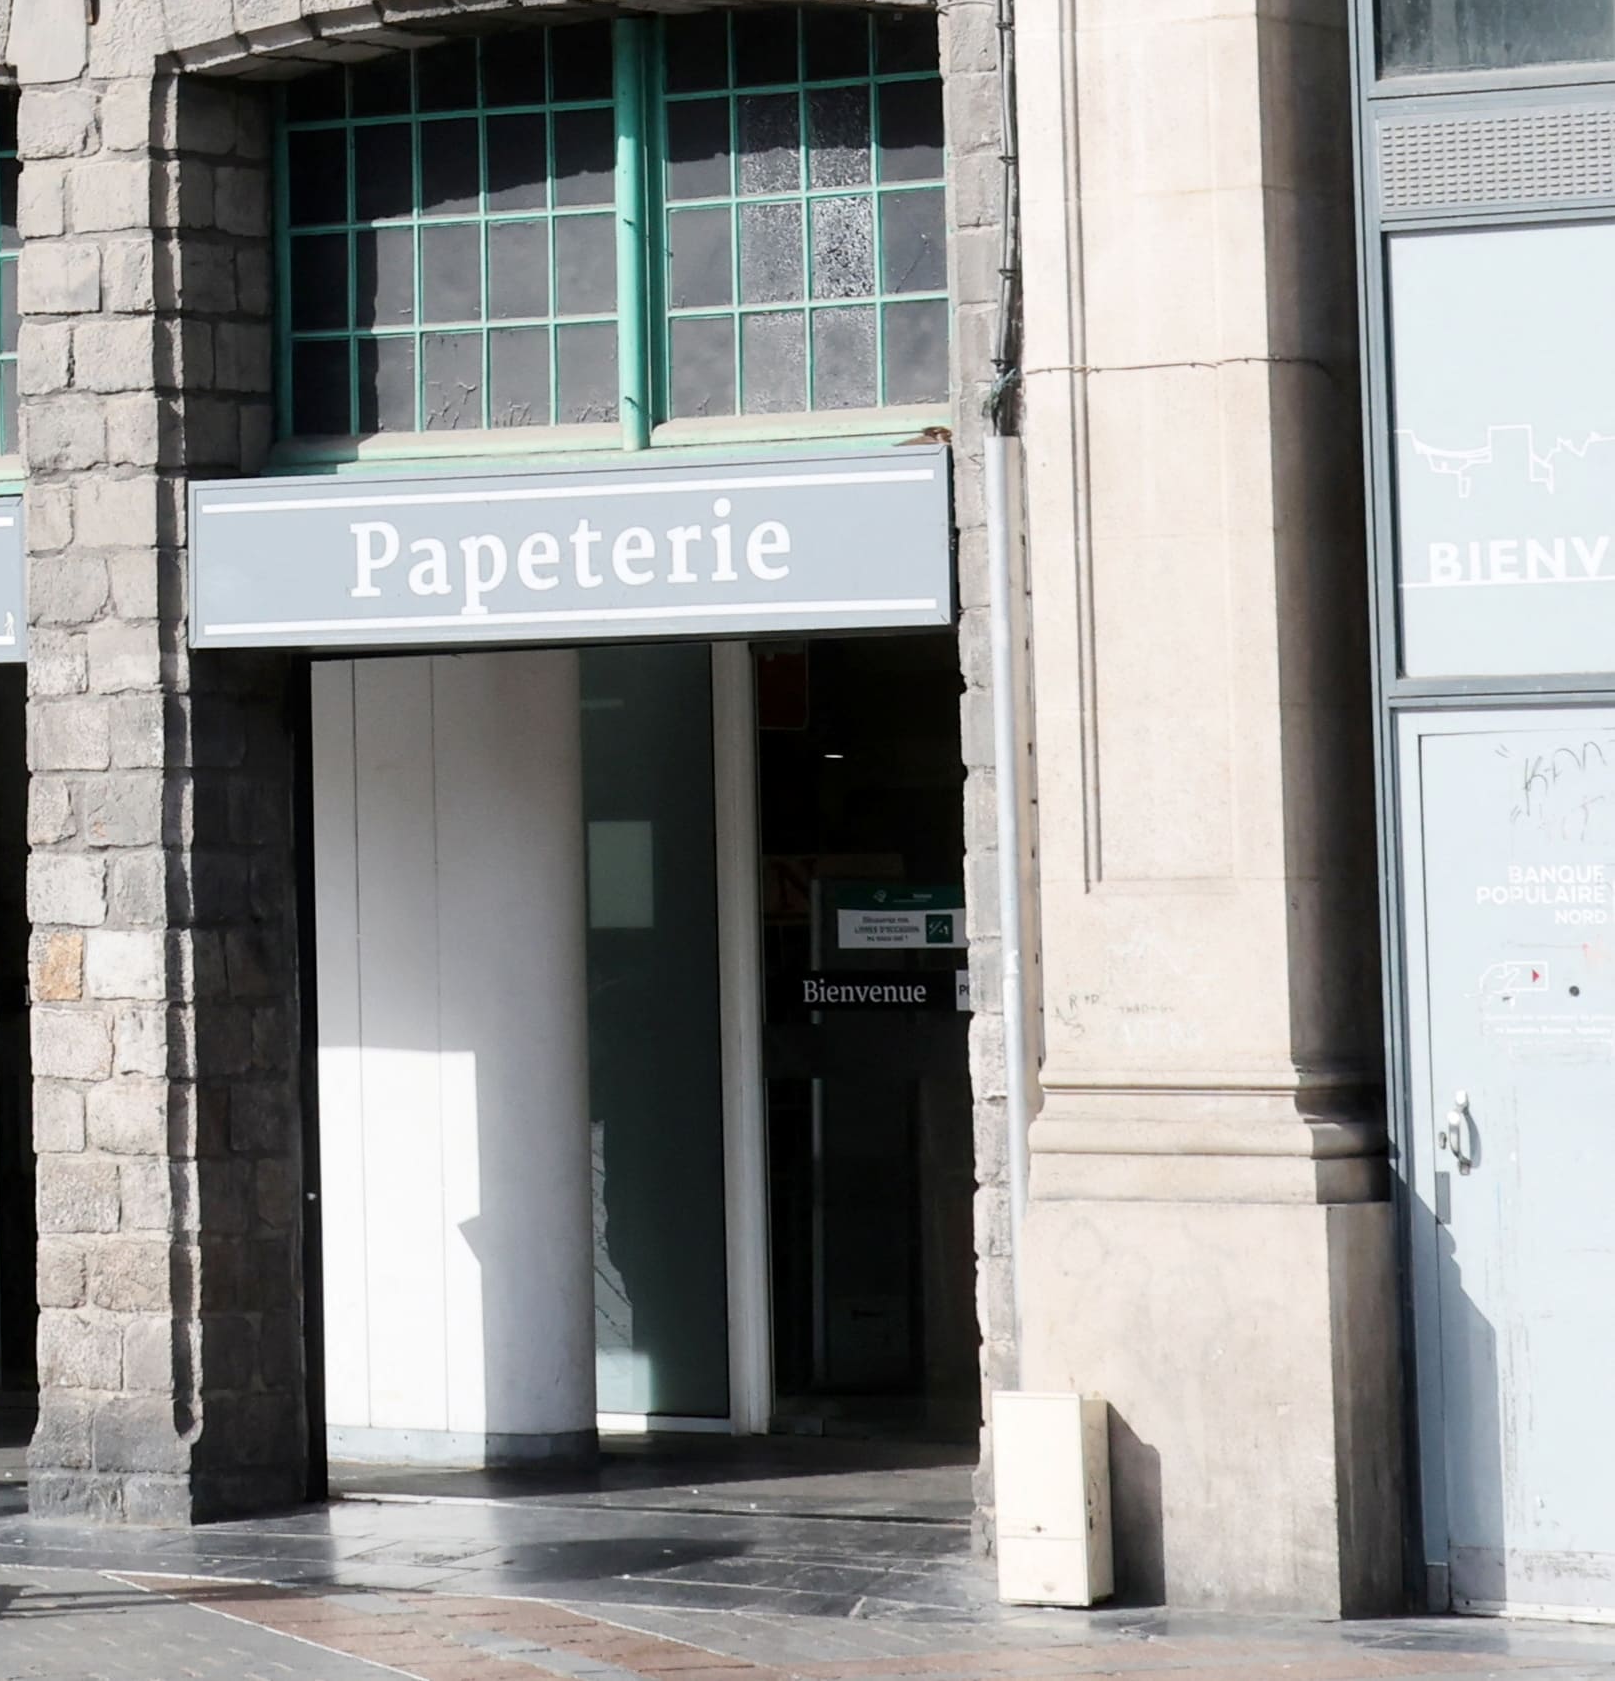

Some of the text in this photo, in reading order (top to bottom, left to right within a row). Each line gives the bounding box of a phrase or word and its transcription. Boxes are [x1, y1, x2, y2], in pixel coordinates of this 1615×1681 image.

[349, 496, 794, 616] Papeterie
[1428, 535, 1611, 583] BIENV
[1507, 865, 1605, 884] BANQUE
[1476, 885, 1607, 905] POPULAIRE
[1554, 909, 1608, 925] NORD
[802, 978, 928, 1004] Bienvenue
